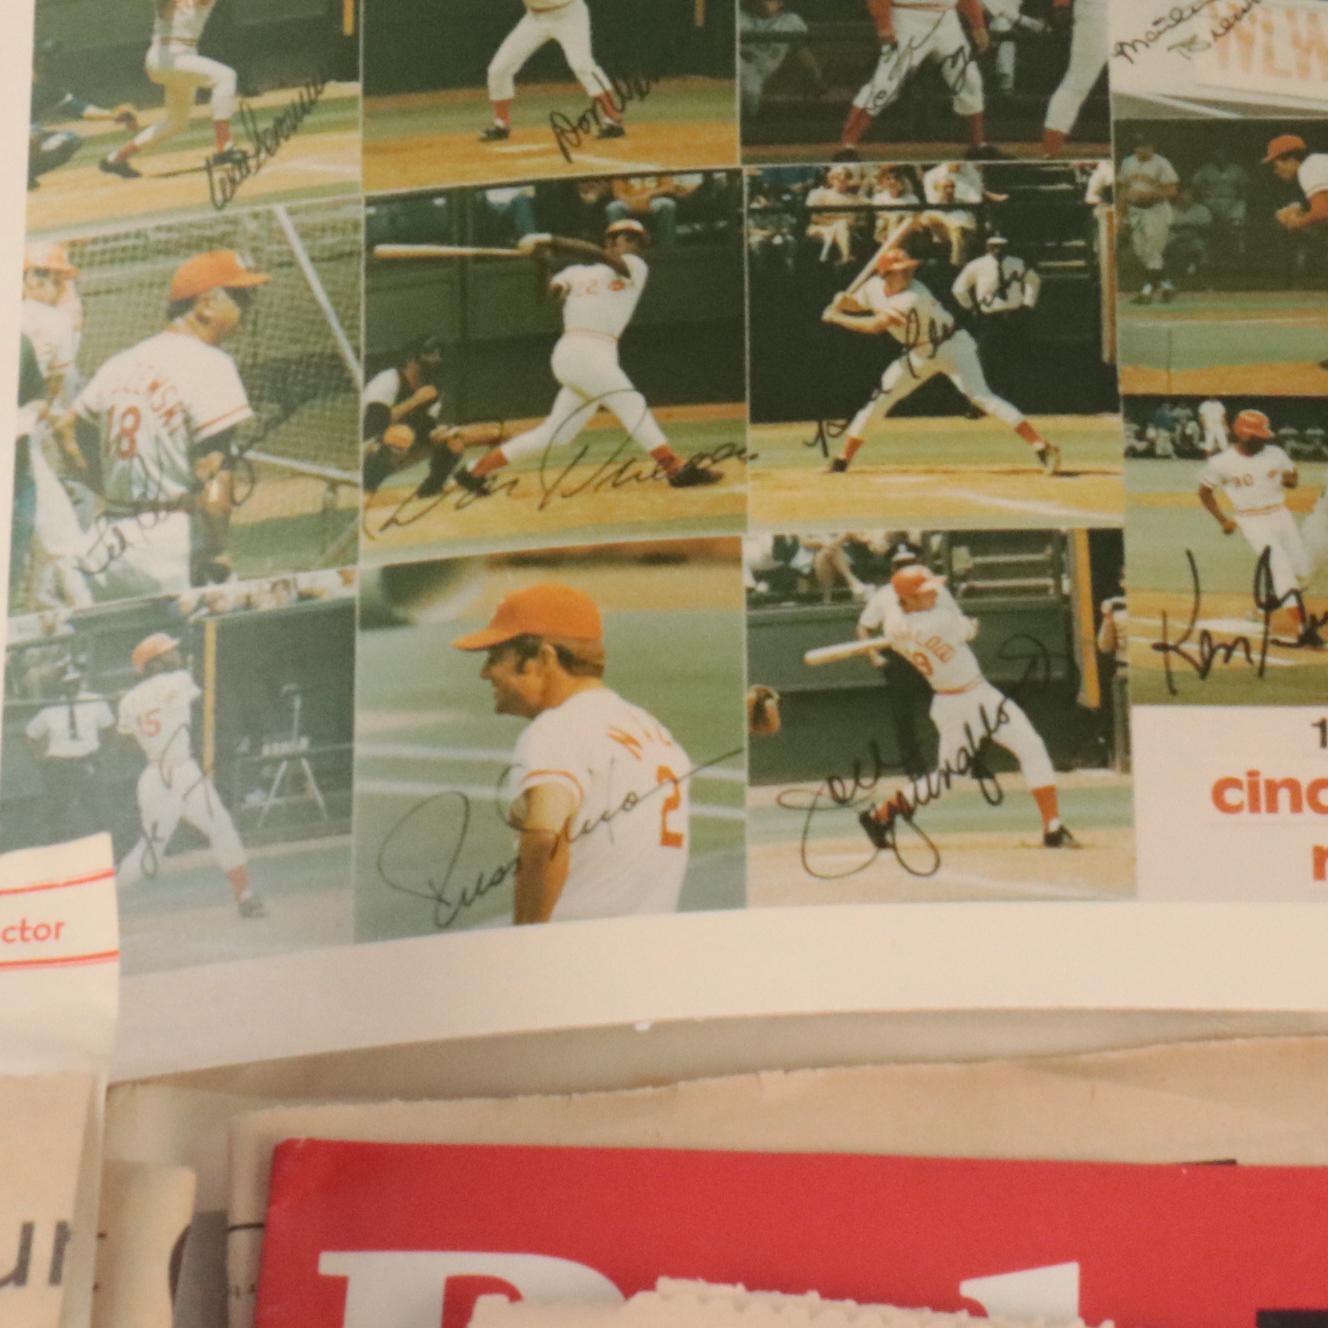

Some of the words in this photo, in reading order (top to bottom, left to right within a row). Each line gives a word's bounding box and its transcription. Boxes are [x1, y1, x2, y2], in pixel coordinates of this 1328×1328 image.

[107, 404, 141, 460] 18
[656, 764, 684, 849] 2
[1, 917, 64, 943] ctor
